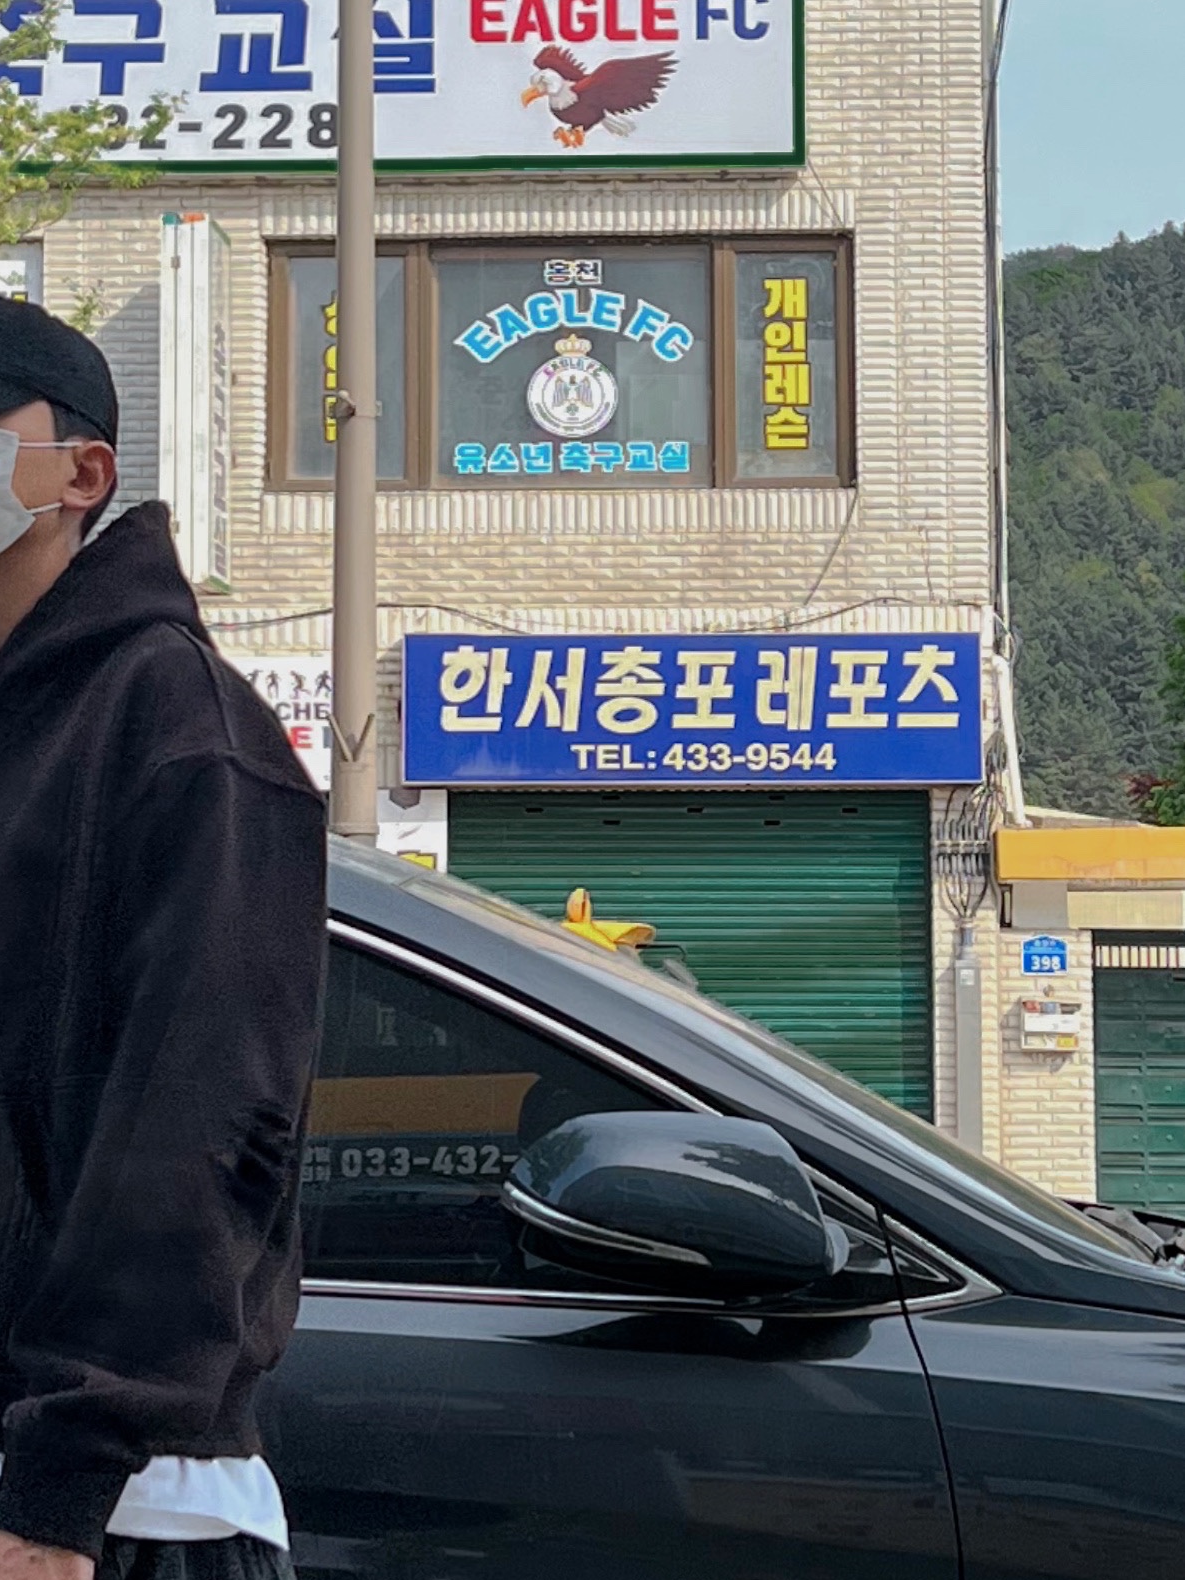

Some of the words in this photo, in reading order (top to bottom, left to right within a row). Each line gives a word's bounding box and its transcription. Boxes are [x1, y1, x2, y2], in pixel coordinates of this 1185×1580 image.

[470, 0, 679, 43] EAGLE
[697, 0, 771, 40] FC
[544, 259, 603, 285] 홍천
[455, 288, 625, 365] EAGLE
[628, 298, 695, 363] FC
[762, 278, 811, 451] 개인레슨
[453, 442, 553, 476] 유소년
[559, 441, 691, 474] 축구교실
[1030, 954, 1061, 972] 398
[341, 1145, 519, 1177] 033-432-
